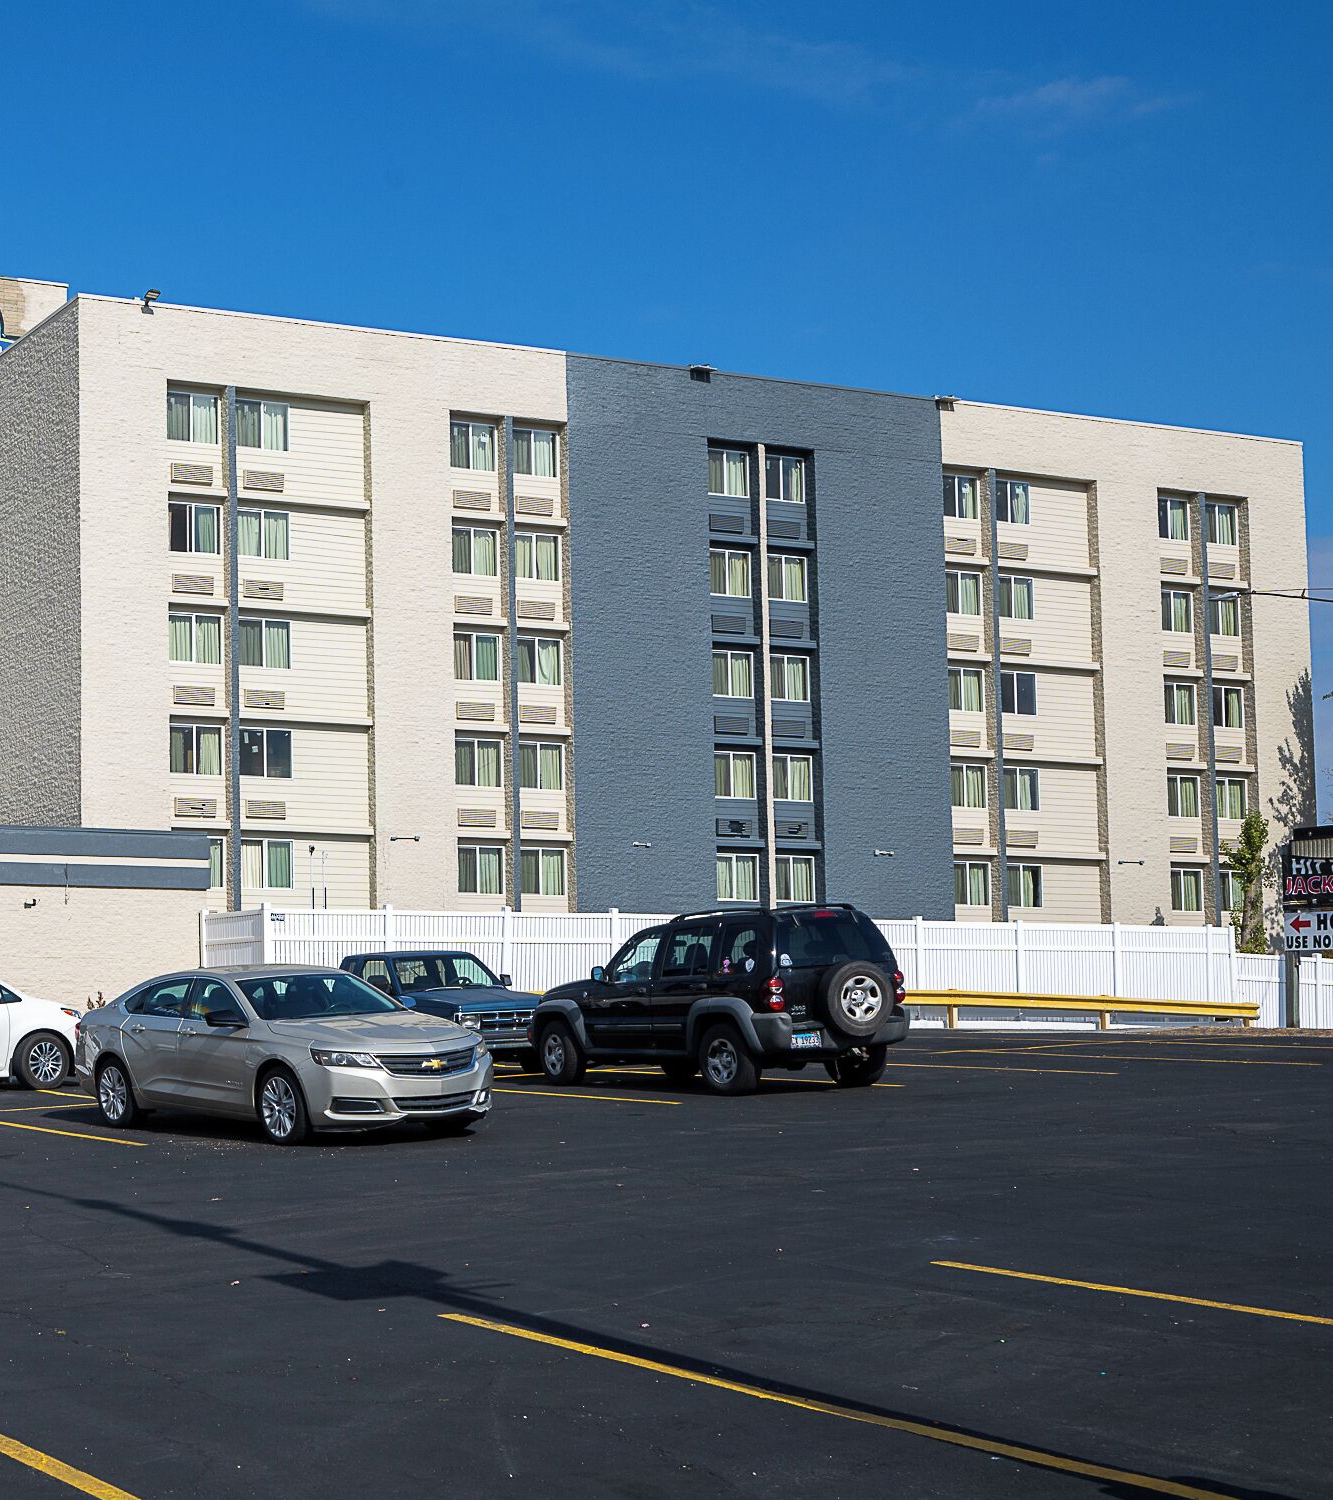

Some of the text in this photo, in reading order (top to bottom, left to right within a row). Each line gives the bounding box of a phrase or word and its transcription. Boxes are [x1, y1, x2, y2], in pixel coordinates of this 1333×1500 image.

[1291, 858, 1326, 875] HIT
[1285, 875, 1333, 895] JACK
[1286, 935, 1308, 949] USE
